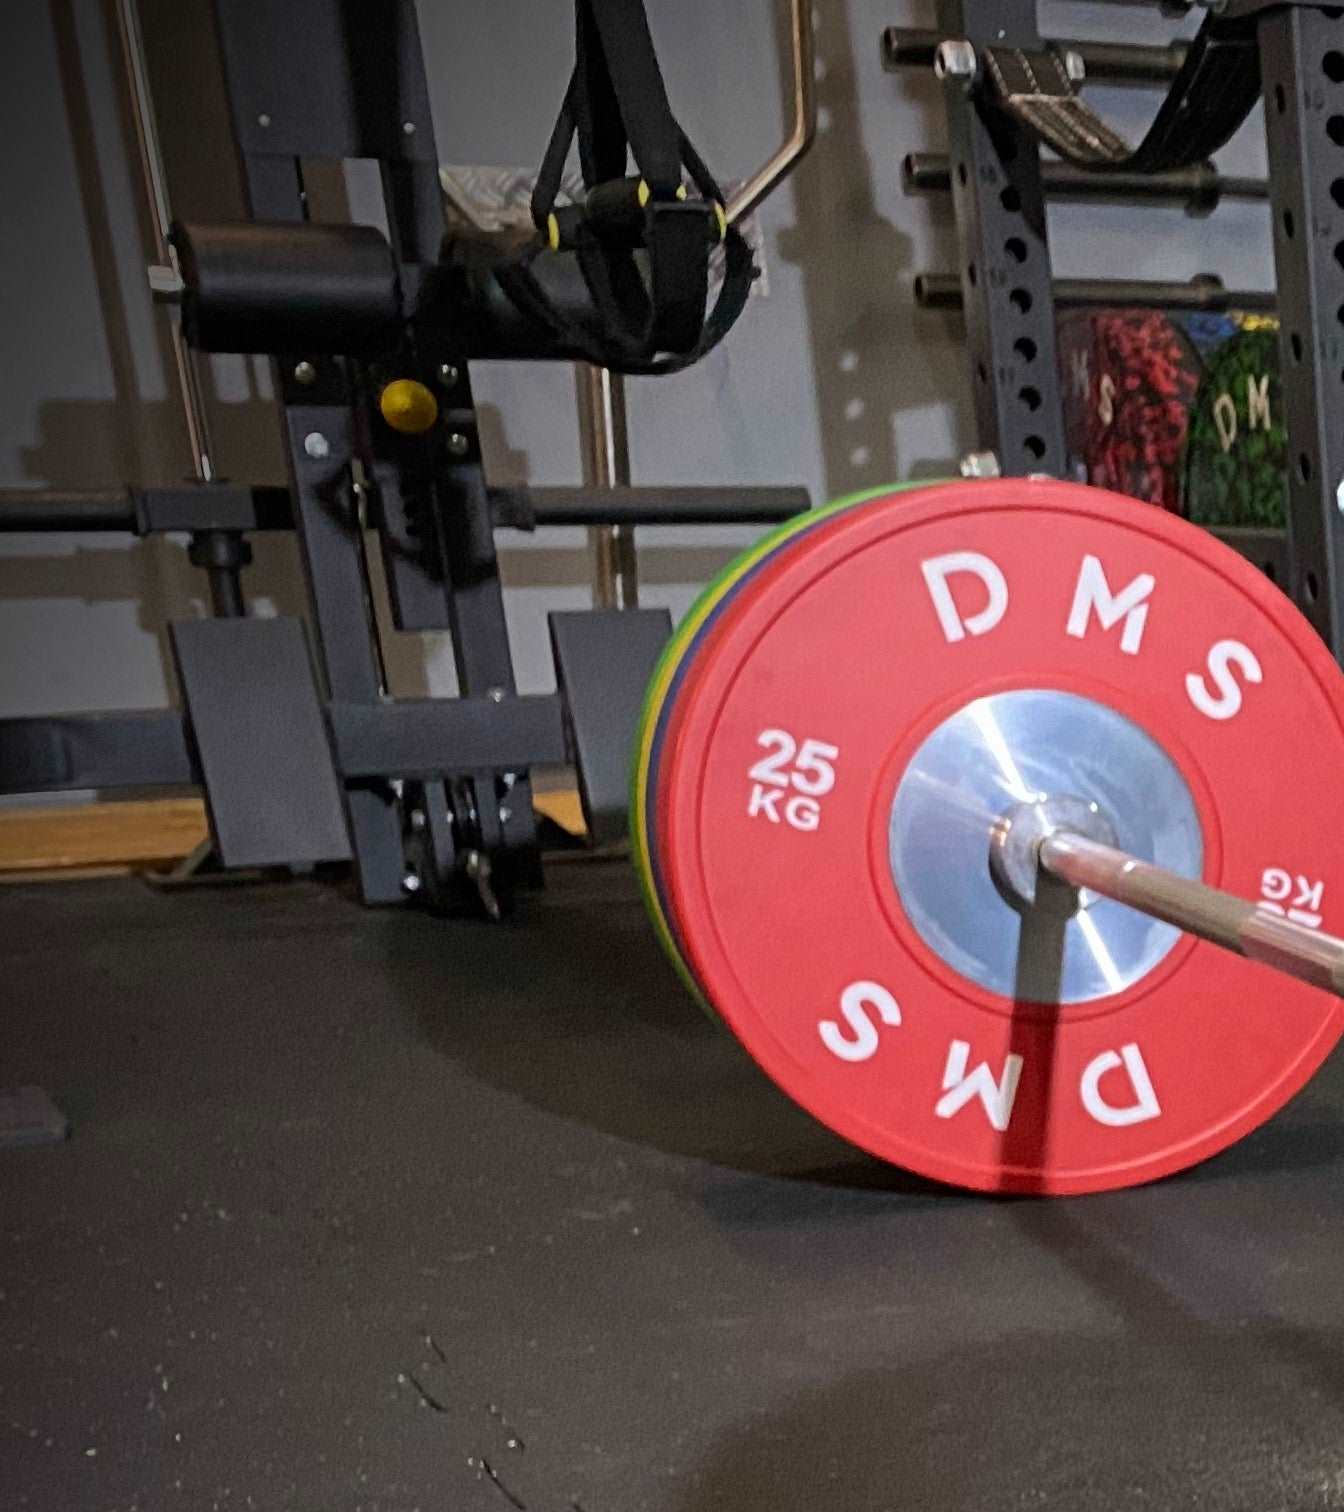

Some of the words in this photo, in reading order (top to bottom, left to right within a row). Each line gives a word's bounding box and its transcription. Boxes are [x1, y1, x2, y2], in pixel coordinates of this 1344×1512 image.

[1212, 372, 1273, 454] DM
[920, 550, 1263, 721] DMS
[748, 728, 839, 798] 25
[747, 788, 822, 832] KG
[1260, 867, 1324, 911] KG
[817, 979, 1162, 1133] DMS
